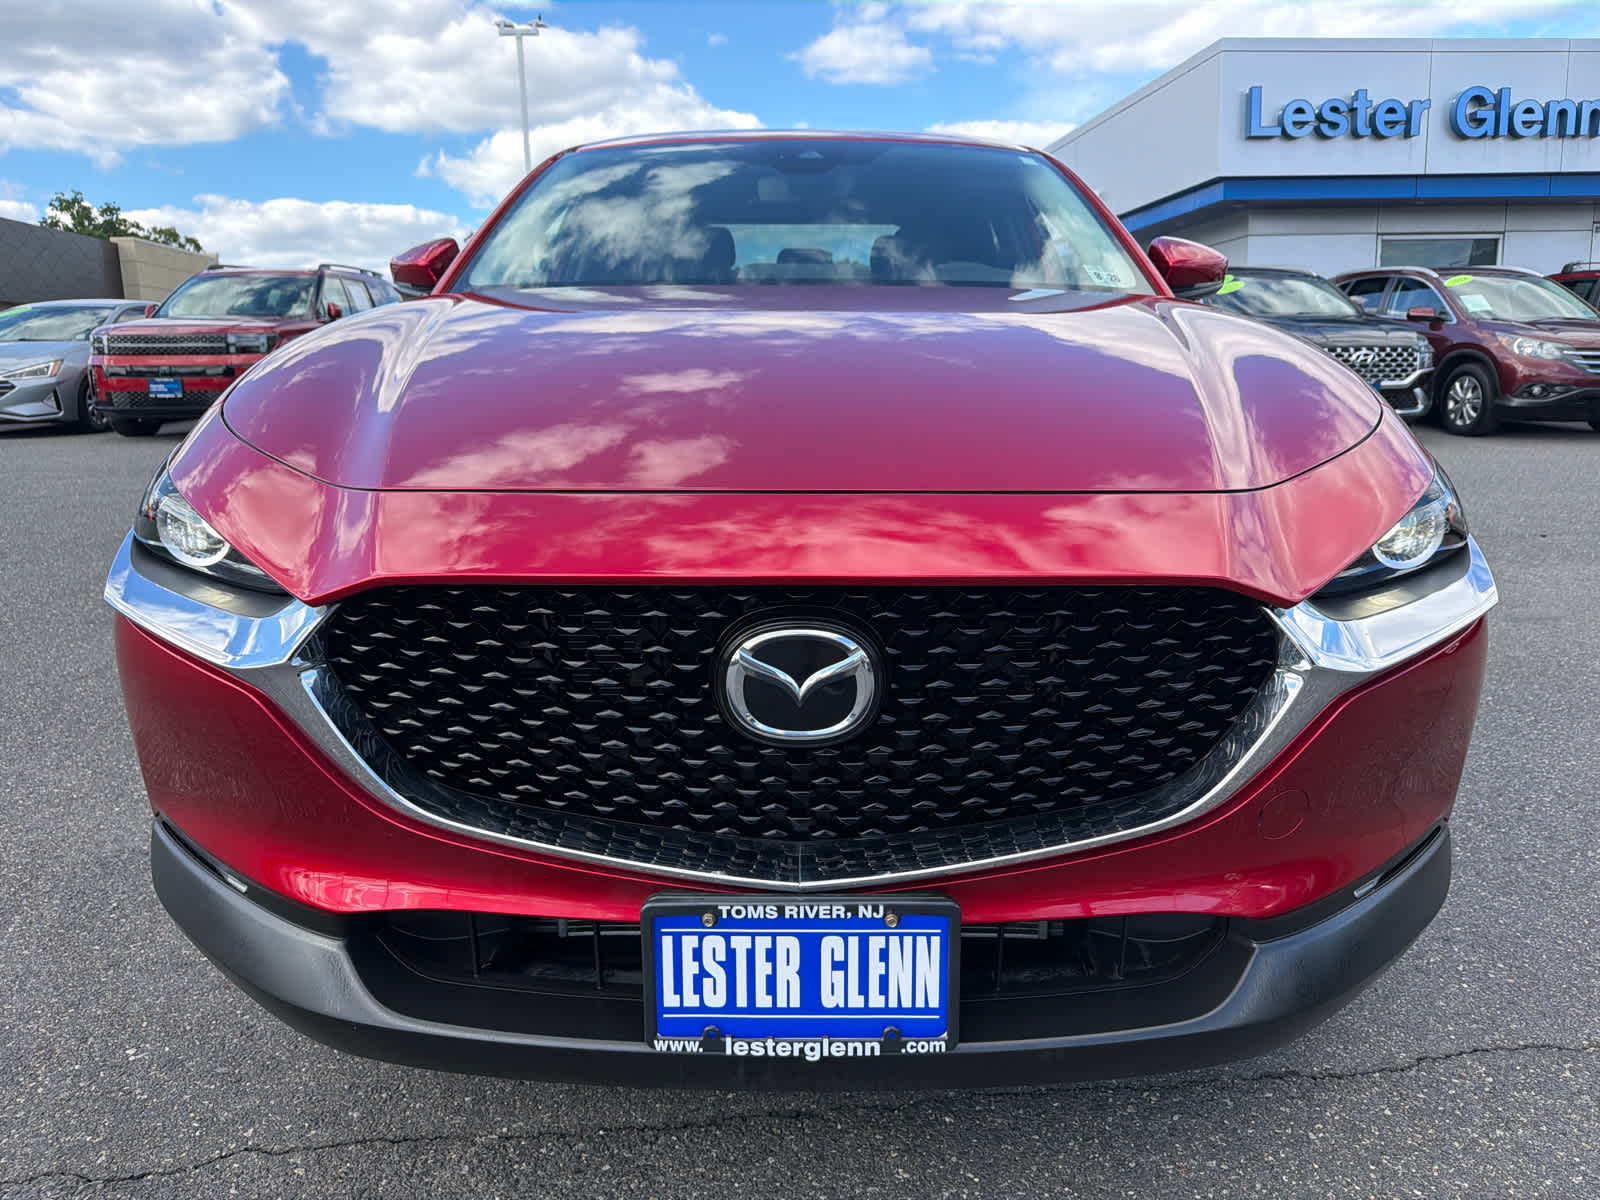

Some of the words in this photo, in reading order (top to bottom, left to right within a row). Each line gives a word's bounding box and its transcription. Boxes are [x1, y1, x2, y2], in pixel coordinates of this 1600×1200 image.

[1247, 85, 1431, 137] Lester
[718, 905, 778, 919] TOMS
[784, 905, 852, 920] RIVER,
[858, 905, 884, 919] NJ
[661, 935, 800, 1008] LESTER
[821, 935, 941, 1008] GLENN
[654, 1039, 703, 1052] www.
[725, 1037, 880, 1061] lesterglenn
[901, 1038, 946, 1053] .com
